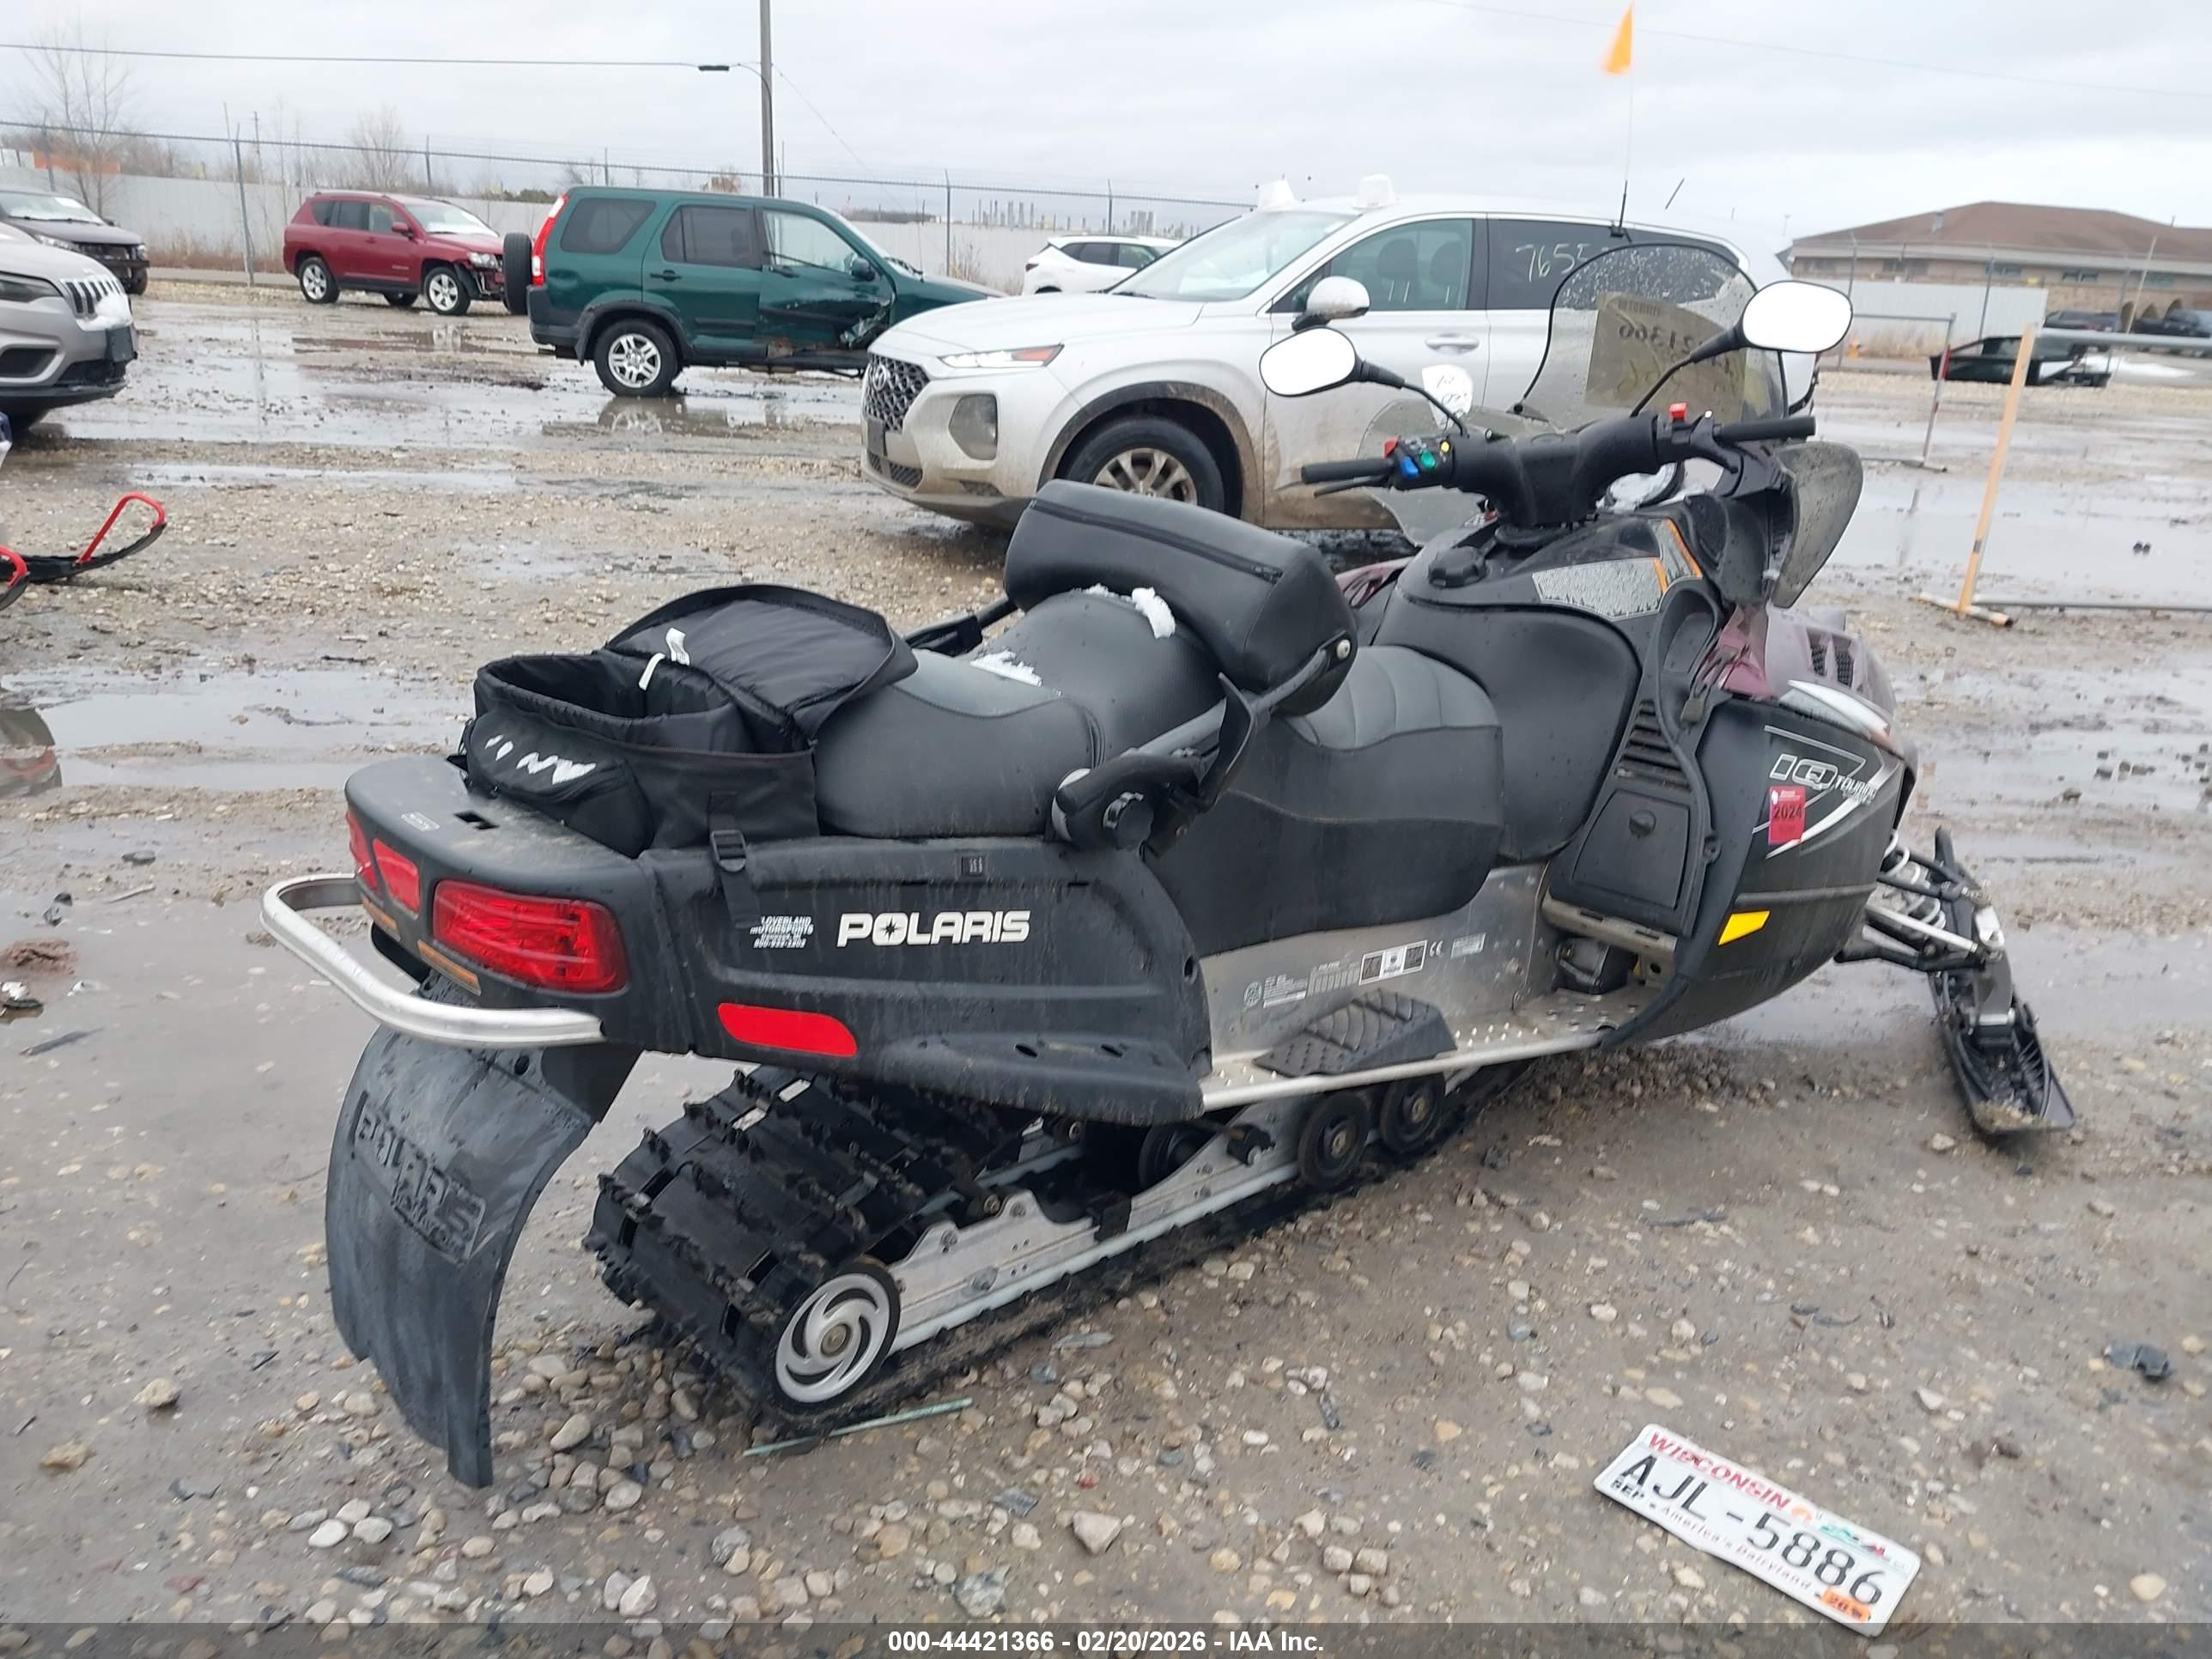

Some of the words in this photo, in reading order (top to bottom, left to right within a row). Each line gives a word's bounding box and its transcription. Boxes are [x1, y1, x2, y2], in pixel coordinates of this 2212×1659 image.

[1769, 753, 1838, 791] IQ
[1773, 804, 1802, 819] 2024
[837, 910, 1031, 948] POLARIS
[1648, 1431, 1794, 1511] WISCONSIN
